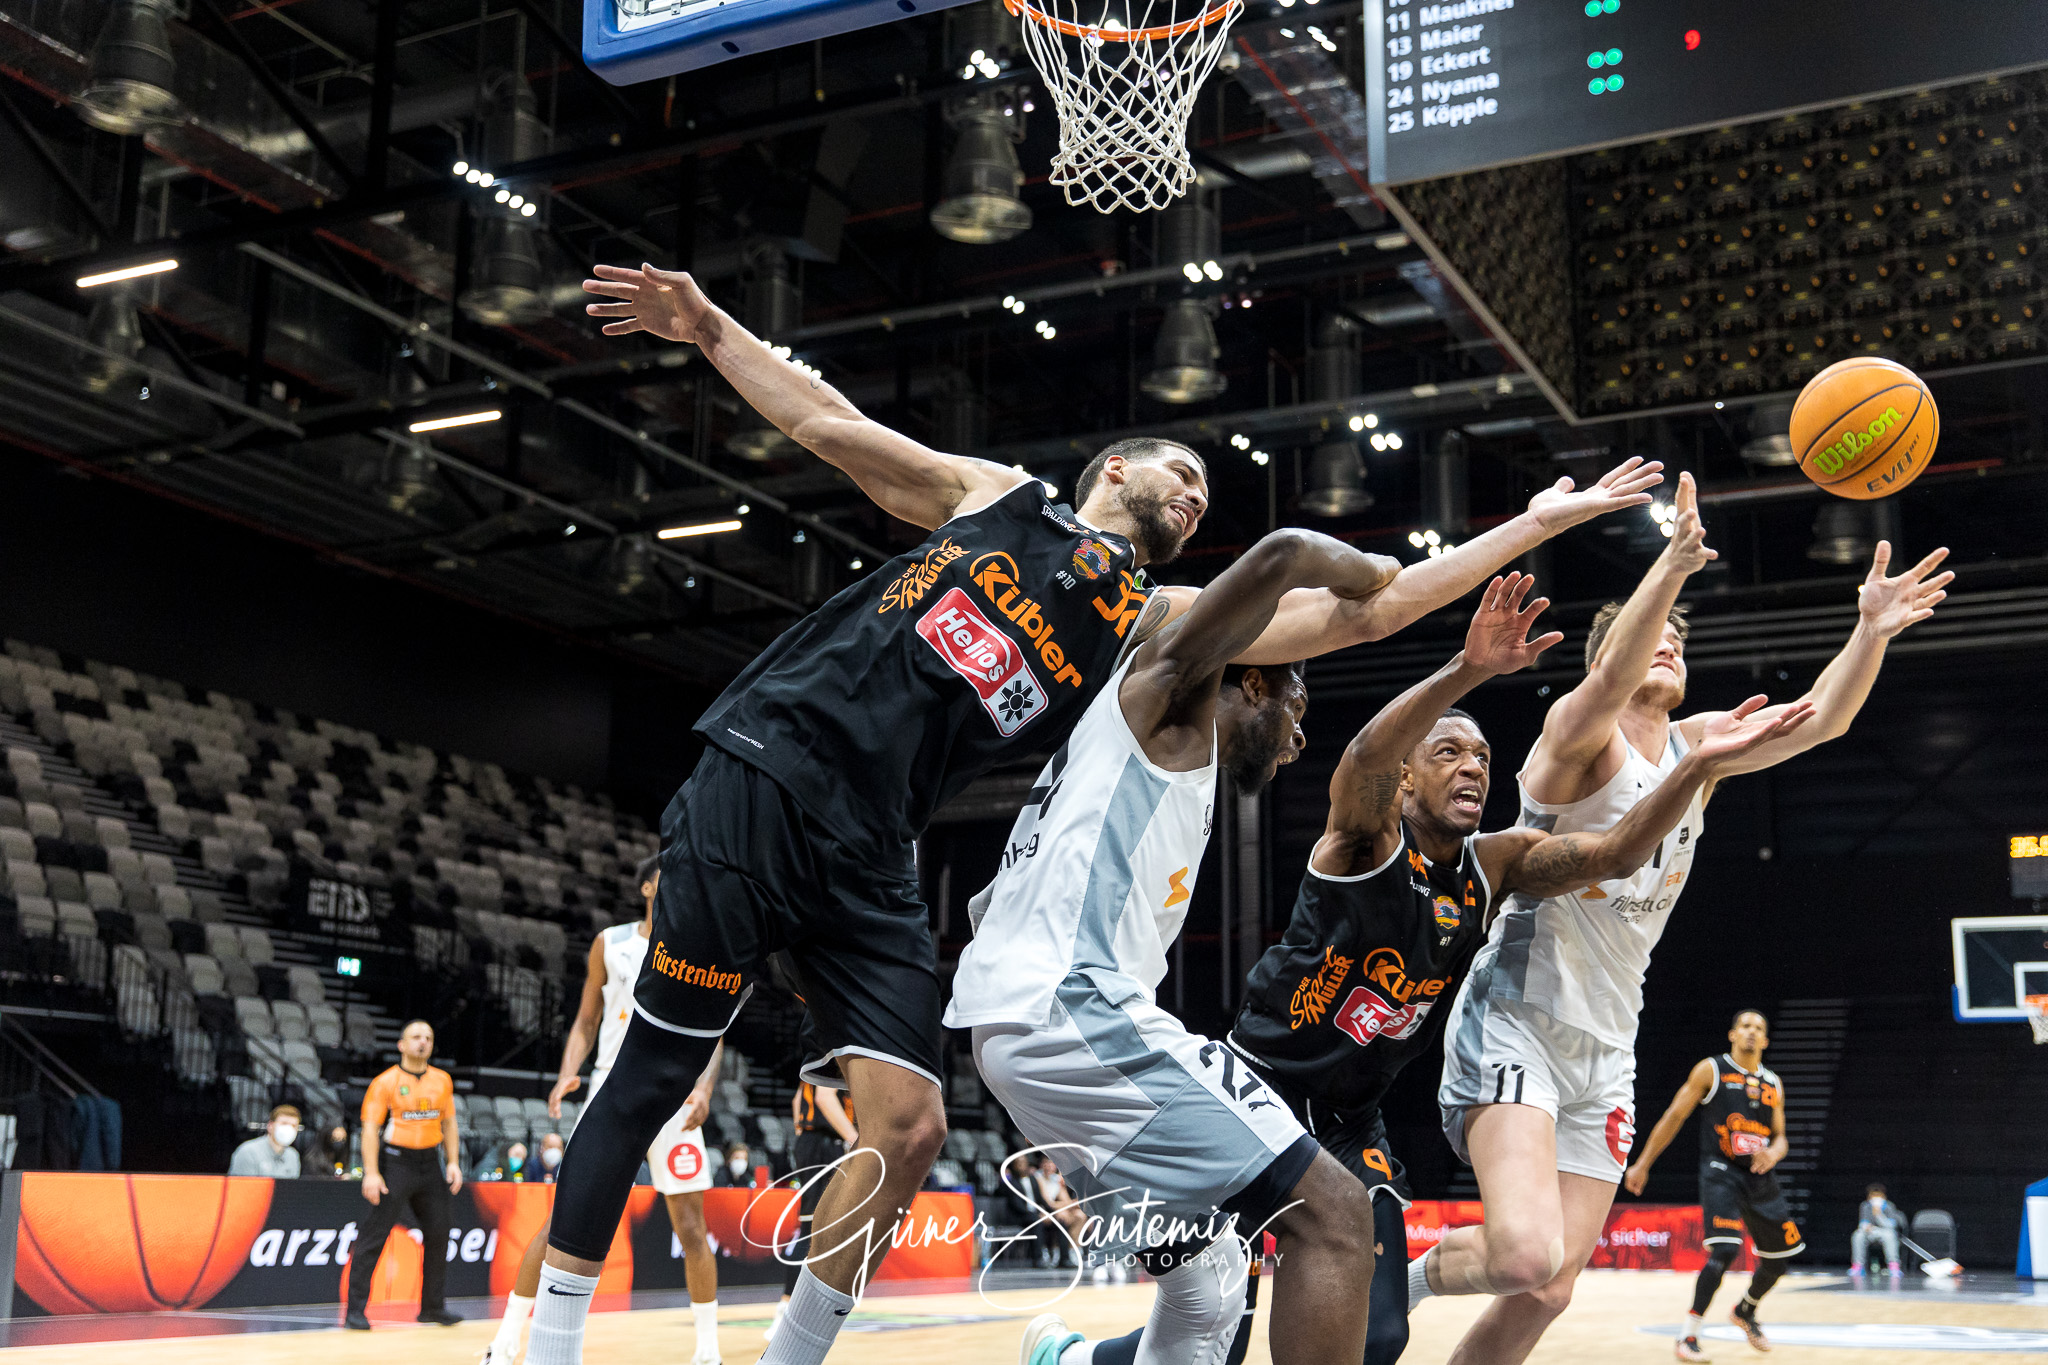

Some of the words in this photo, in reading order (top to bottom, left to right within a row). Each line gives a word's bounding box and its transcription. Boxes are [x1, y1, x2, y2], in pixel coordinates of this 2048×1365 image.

[1386, 11, 1410, 33] 11
[1387, 36, 1412, 57] 13
[1421, 24, 1484, 51] Maier
[1388, 61, 1413, 82] 19
[1421, 46, 1491, 76] Eckert
[1387, 86, 1414, 108] 24
[1422, 72, 1499, 103] Nyama
[1388, 110, 1414, 134] 25
[1422, 96, 1498, 127] Köpple
[1813, 406, 1902, 475] Wilson
[1041, 504, 1074, 532] SPALDING
[902, 562, 919, 579] DER
[906, 545, 972, 609] MÜLLER
[1055, 569, 1077, 591] #10
[972, 561, 1083, 688] Kübler
[934, 606, 1006, 683] Helios
[1299, 976, 1312, 992] DER
[1311, 953, 1355, 1025] MÜLLER
[1491, 1062, 1526, 1105] 11
[1610, 1226, 1672, 1247] sicher
